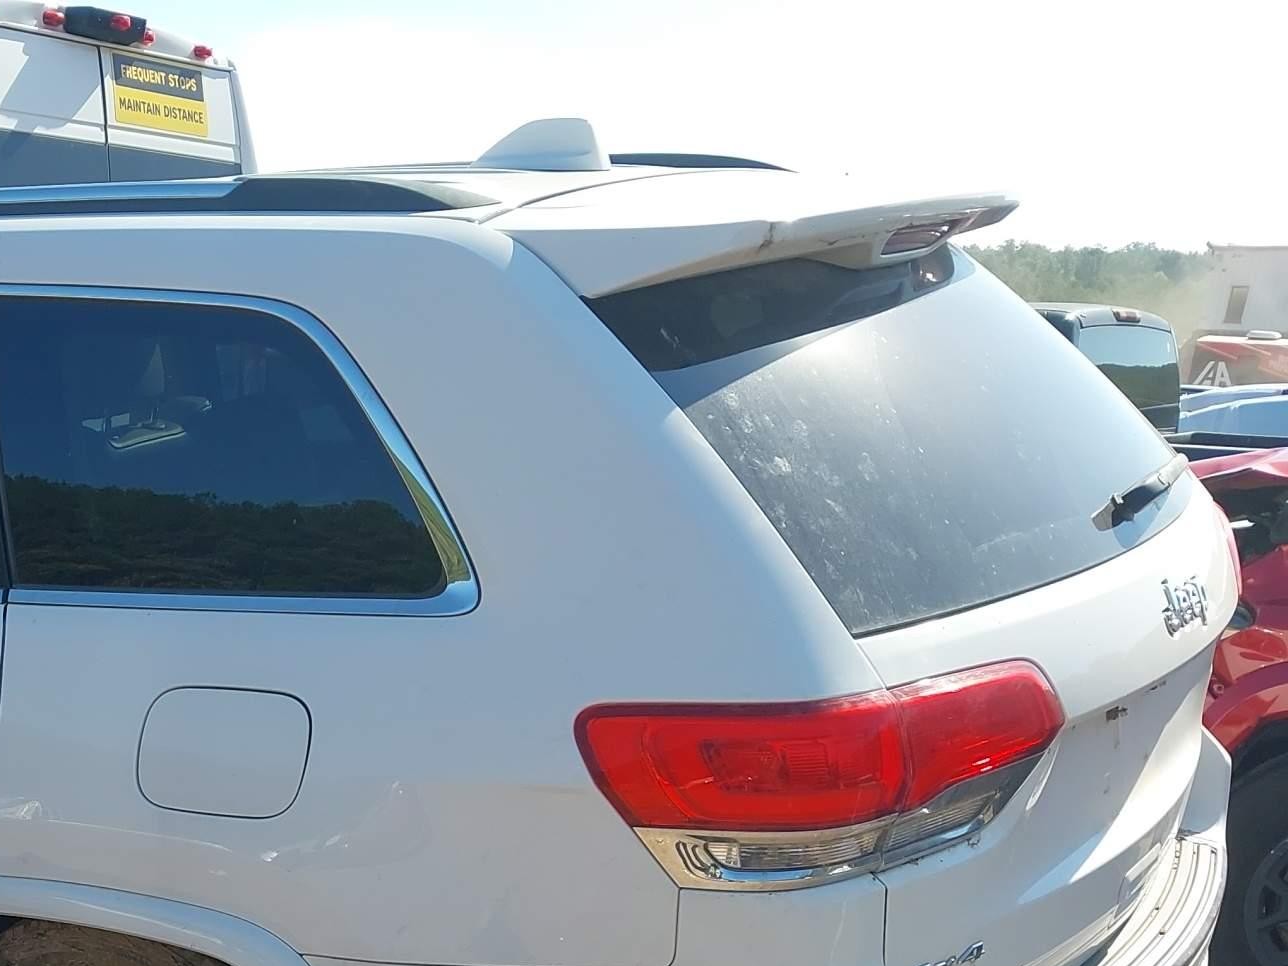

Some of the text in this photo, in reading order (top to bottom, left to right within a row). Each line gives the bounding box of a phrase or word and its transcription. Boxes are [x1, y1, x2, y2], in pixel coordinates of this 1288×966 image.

[120, 64, 197, 92] FREQUENT STOPS
[119, 96, 204, 124] MAINTAIN DISTANCE
[1161, 577, 1207, 638] Jeep
